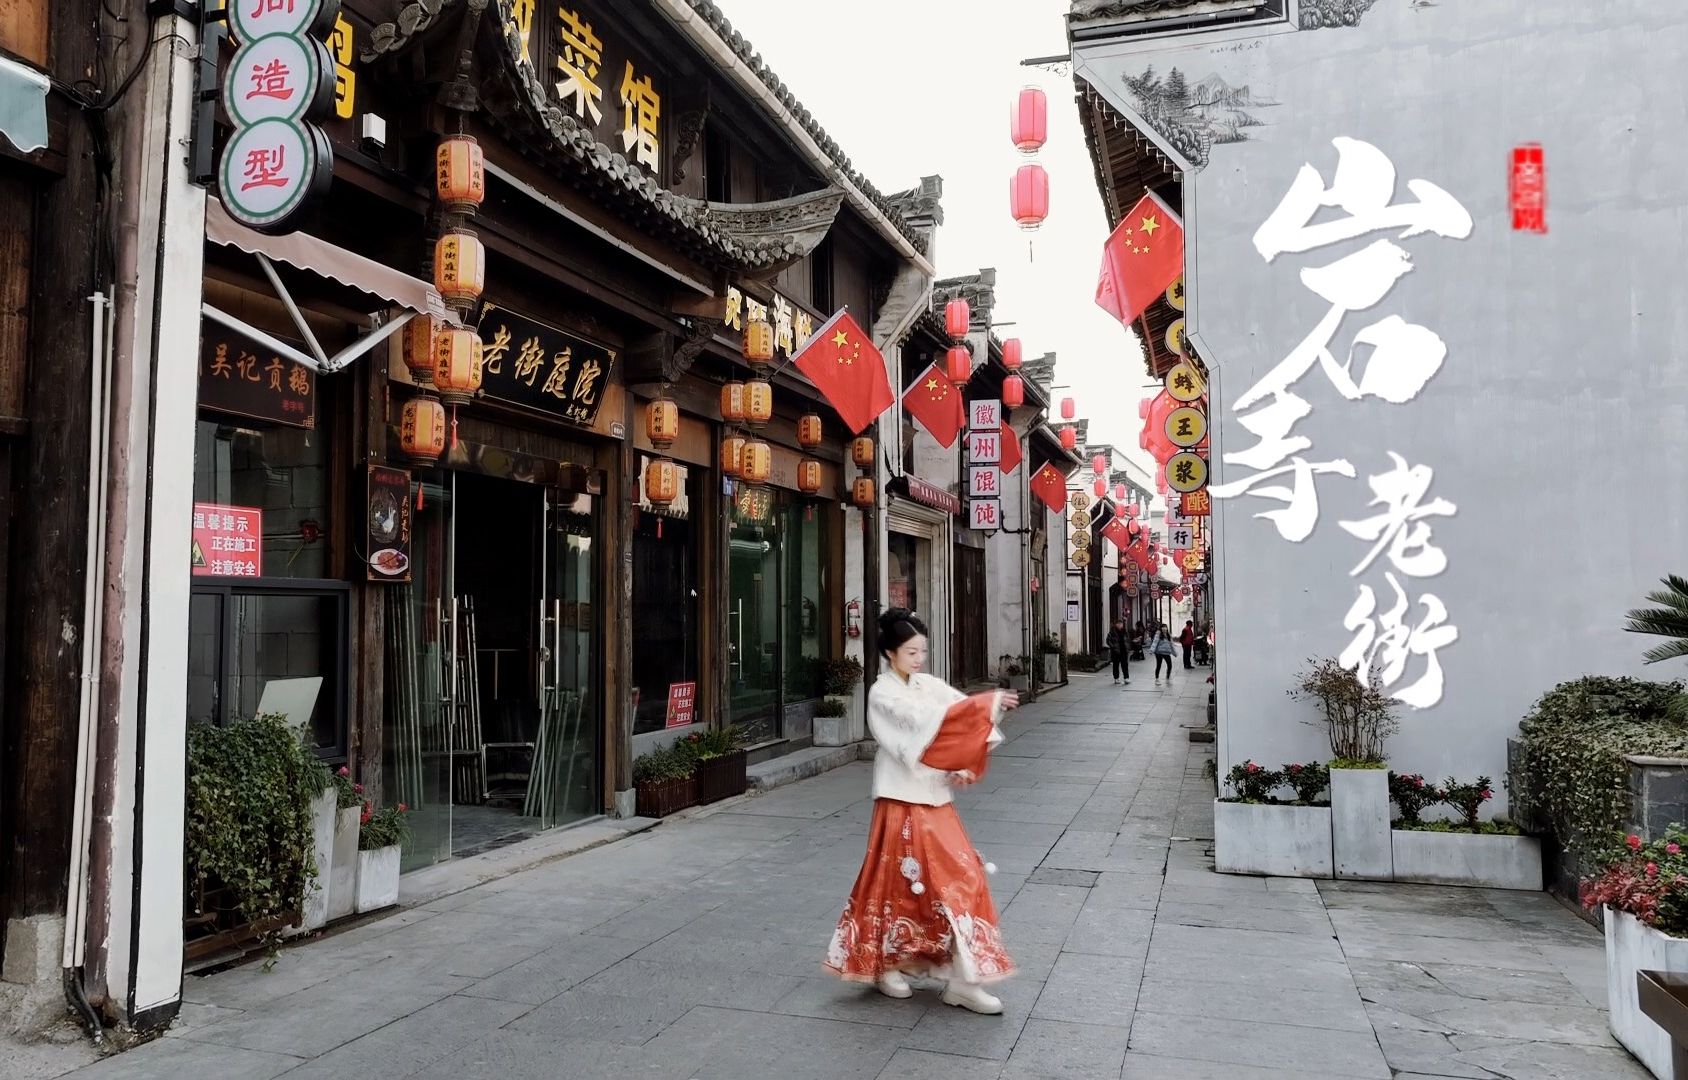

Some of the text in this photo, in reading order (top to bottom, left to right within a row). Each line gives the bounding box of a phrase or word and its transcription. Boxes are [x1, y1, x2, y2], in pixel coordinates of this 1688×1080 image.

[974, 404, 996, 525] 徽州馄饨
[193, 512, 249, 533] 温馨提示
[210, 535, 257, 553] 正在施工
[210, 559, 256, 576] 注意安全
